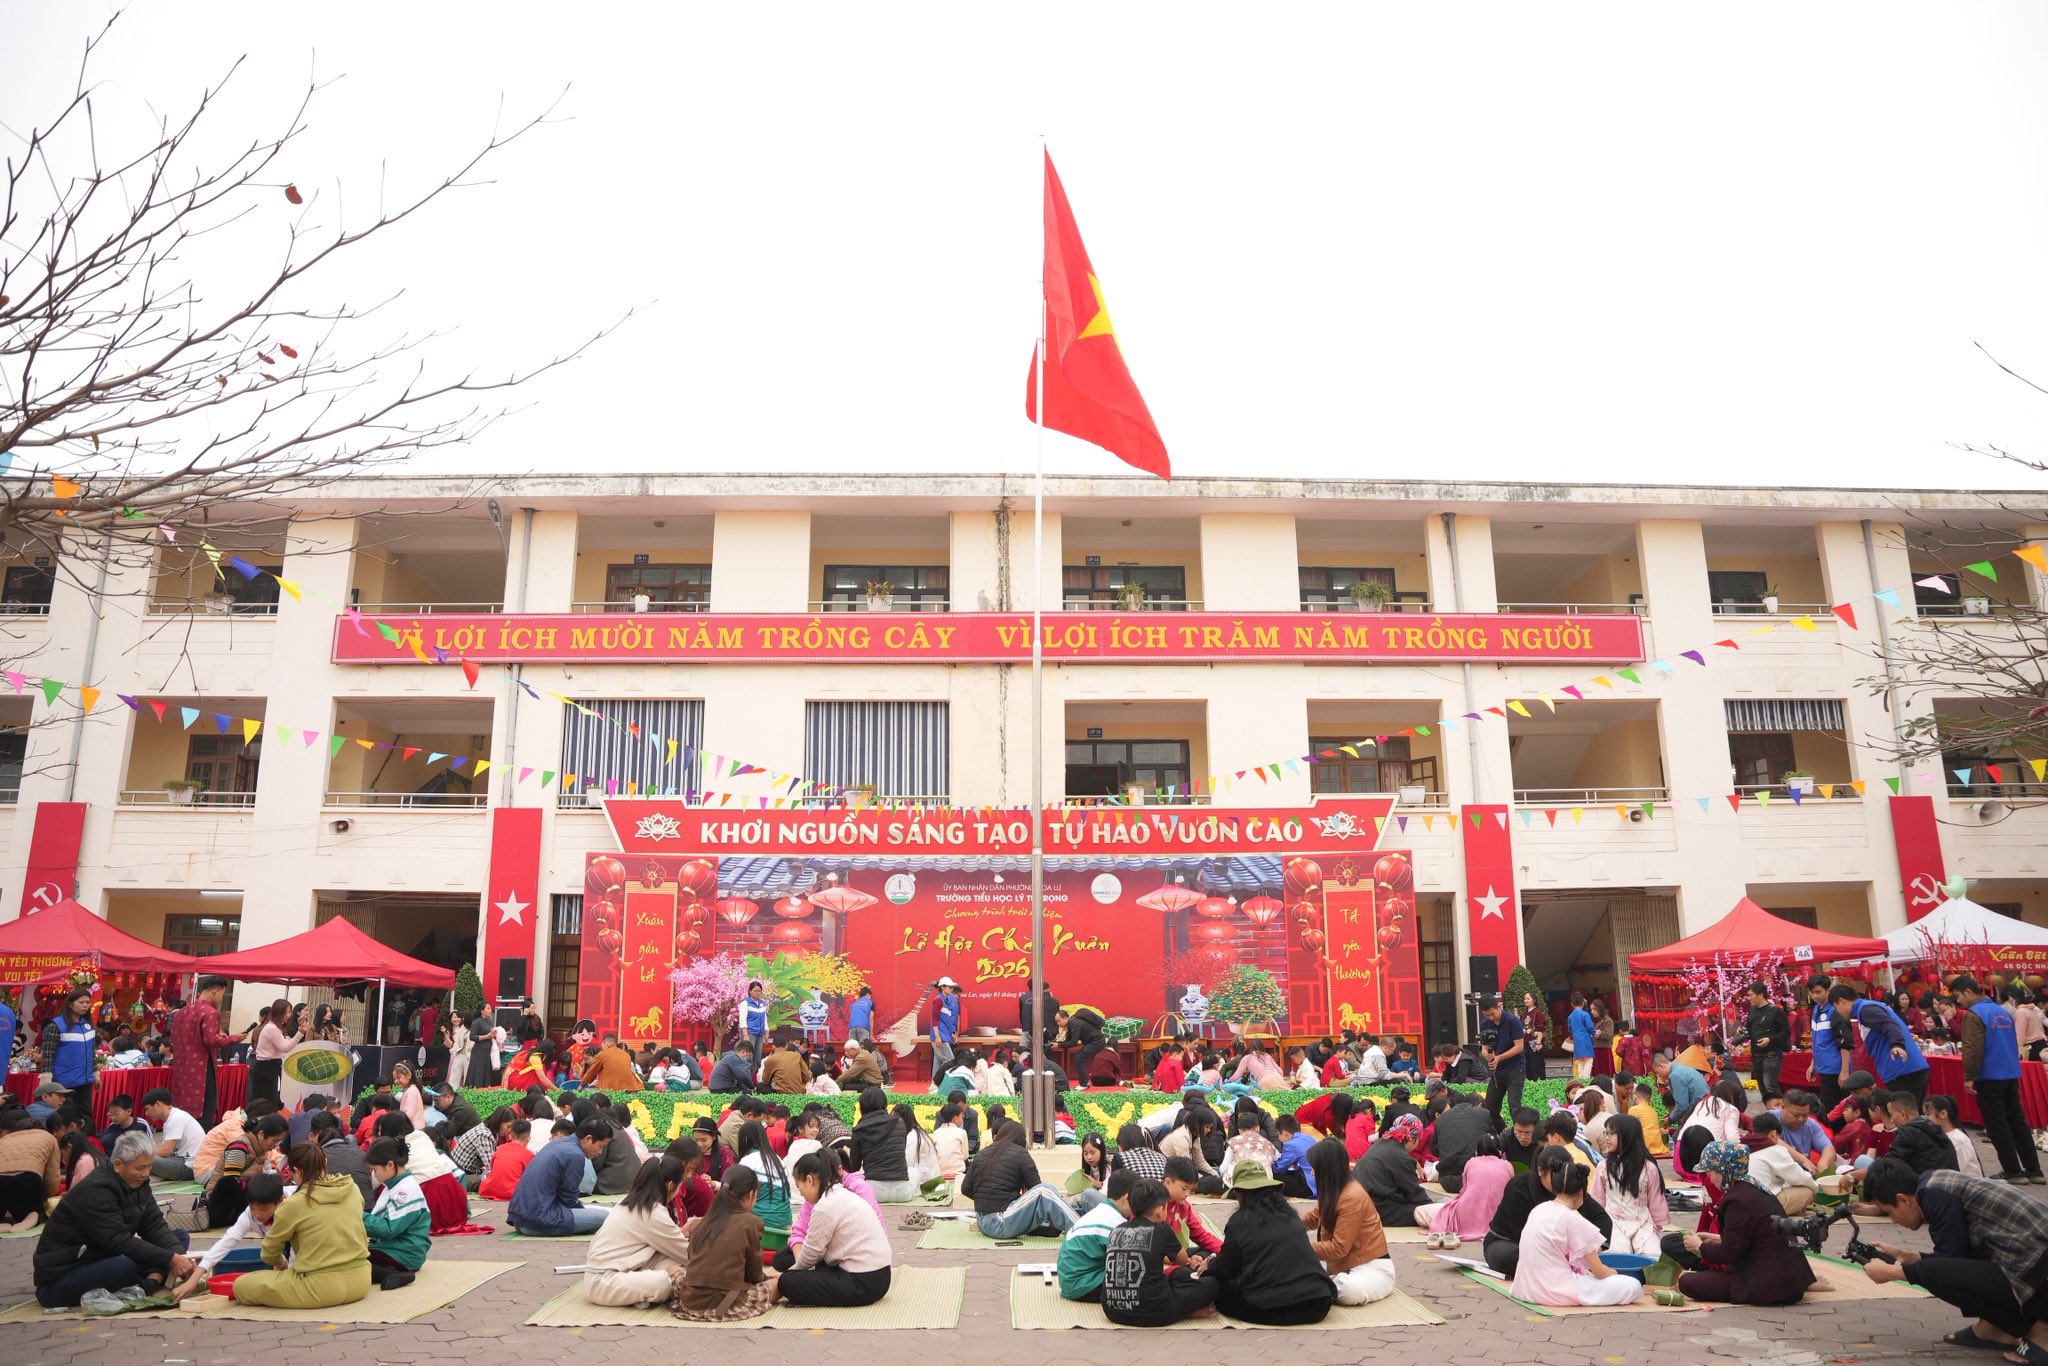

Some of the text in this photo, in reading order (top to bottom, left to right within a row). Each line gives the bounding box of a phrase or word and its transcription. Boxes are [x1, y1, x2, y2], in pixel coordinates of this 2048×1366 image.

[436, 624, 487, 656] LỢI
[498, 619, 557, 649] ÍCH
[570, 619, 655, 649] MƯỜI
[668, 621, 744, 649] NĂM
[757, 616, 872, 650] TRỒNG
[884, 621, 956, 649] CÂY
[995, 616, 1593, 655] VÌ LỢI ÍCH TRĂM NĂM TRỒNG NGƯỜI
[700, 812, 1029, 851] KHƠI NGUỒN SÁNG TẠO
[1048, 818, 1087, 850] TỰ
[1246, 820, 1304, 844] CAO
[936, 892, 973, 902] TRƯỜNG
[973, 891, 991, 902] TIỂU
[992, 894, 1013, 904] HỌC
[1015, 893, 1025, 902] LÝ
[1043, 894, 1069, 904] RỌNG
[968, 883, 988, 891] NHÂN
[989, 883, 1005, 891] DÂN
[636, 911, 665, 927] Xuân
[1339, 907, 1360, 924] Tết
[981, 926, 1034, 956] Chà
[1052, 923, 1111, 956] Xuân
[1798, 950, 1811, 958] 4A
[976, 957, 1031, 983] 2026
